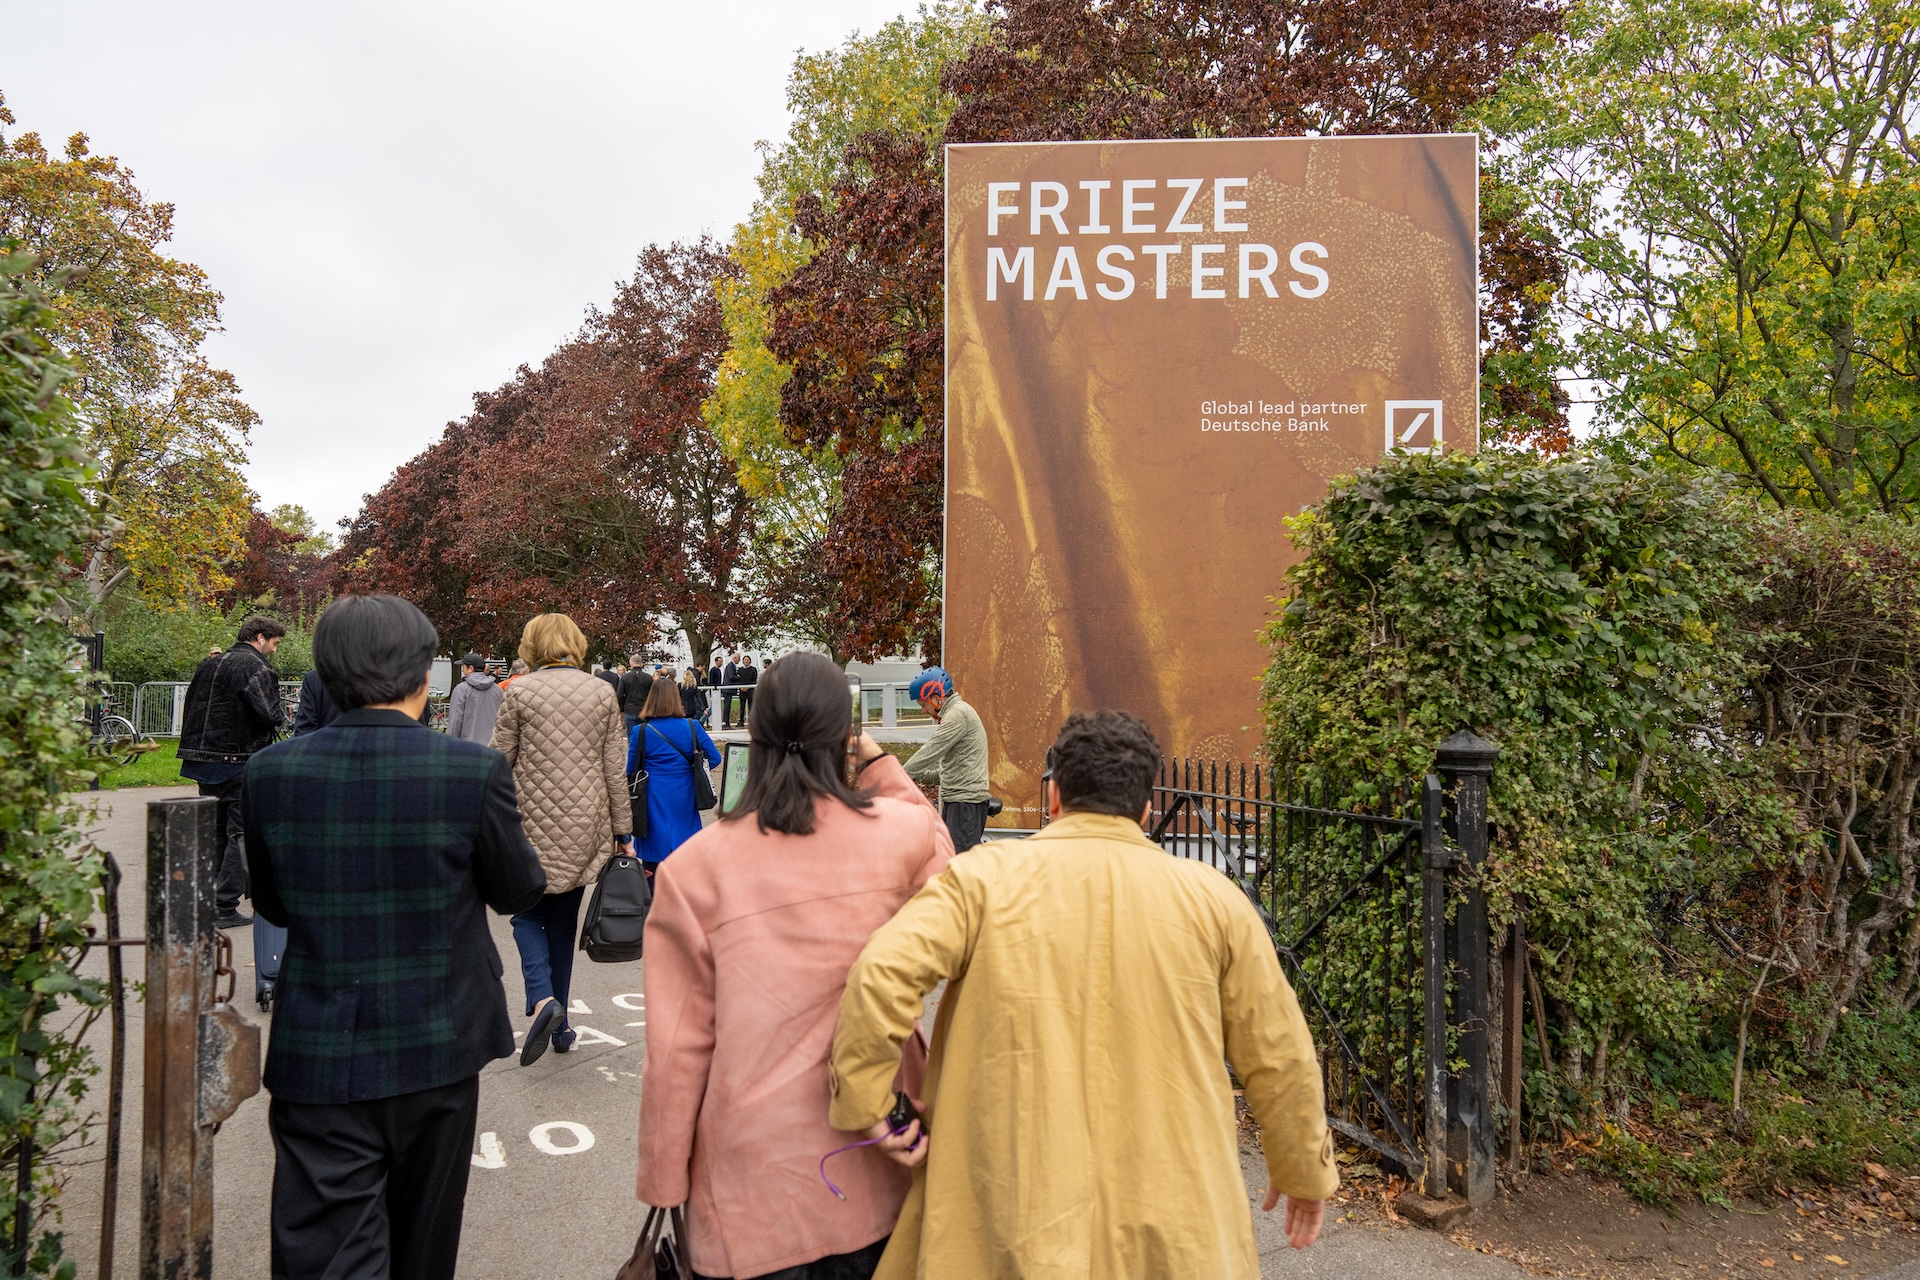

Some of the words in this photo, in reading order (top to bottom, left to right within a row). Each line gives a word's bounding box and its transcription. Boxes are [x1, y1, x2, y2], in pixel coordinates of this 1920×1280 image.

[987, 178, 1249, 236] FRIEZE
[986, 242, 1330, 301] MASTERS
[1201, 400, 1253, 415] Global
[1258, 400, 1295, 415] lead
[1301, 401, 1368, 418] partner
[1201, 417, 1282, 432] Deutsche
[1288, 417, 1329, 432] Bank
